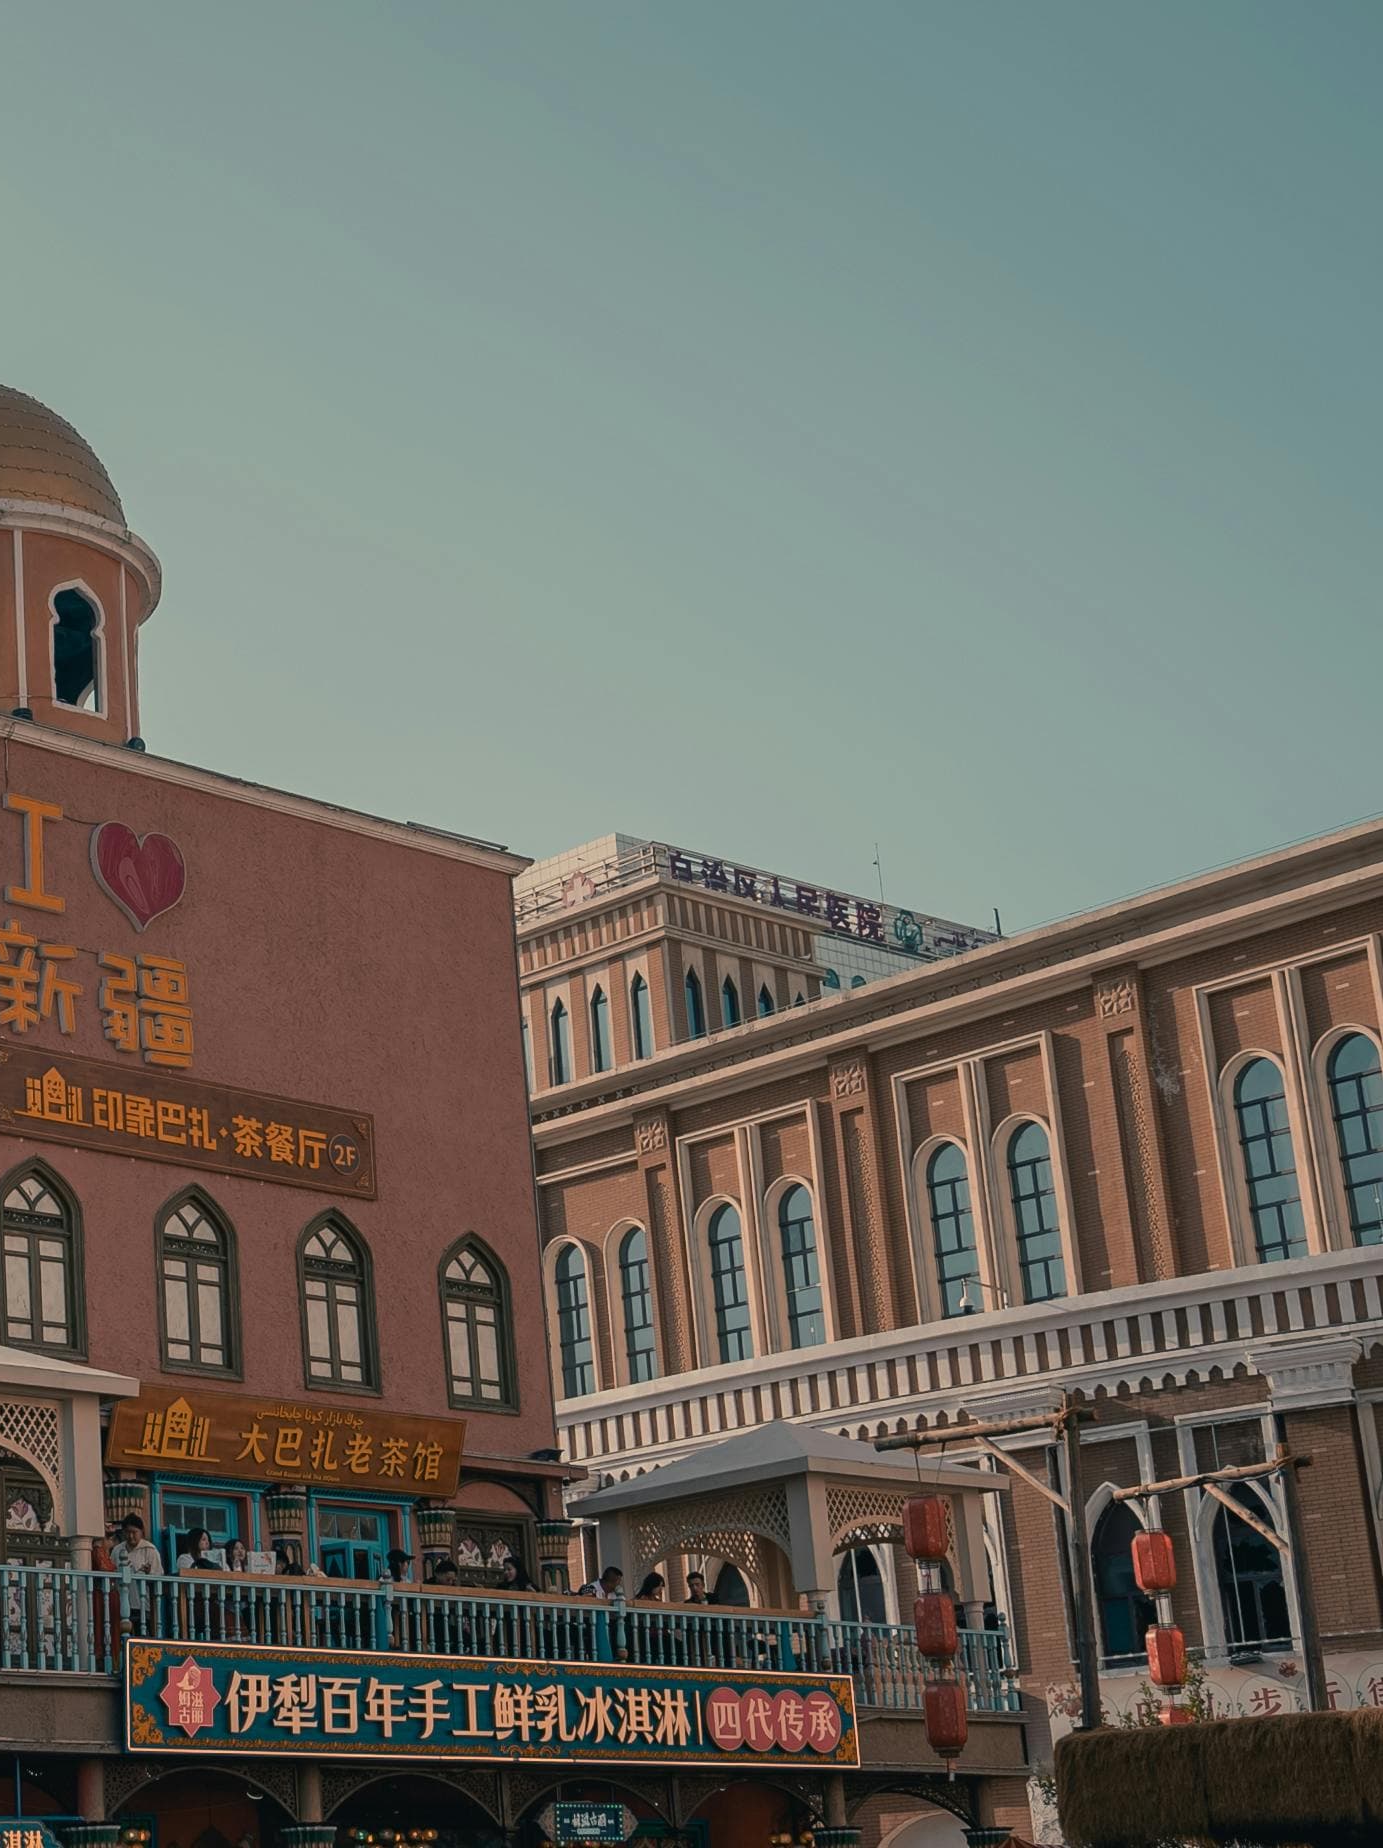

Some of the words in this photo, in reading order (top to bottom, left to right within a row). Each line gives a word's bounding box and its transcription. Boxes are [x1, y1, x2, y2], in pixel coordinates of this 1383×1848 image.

[334, 1143, 356, 1167] 2F
[235, 1423, 444, 1481] 大巴扎老茶馆
[224, 1670, 692, 1746] 伊犁百年手工鲜乳冰淇淋
[711, 1698, 838, 1743] 四代传承
